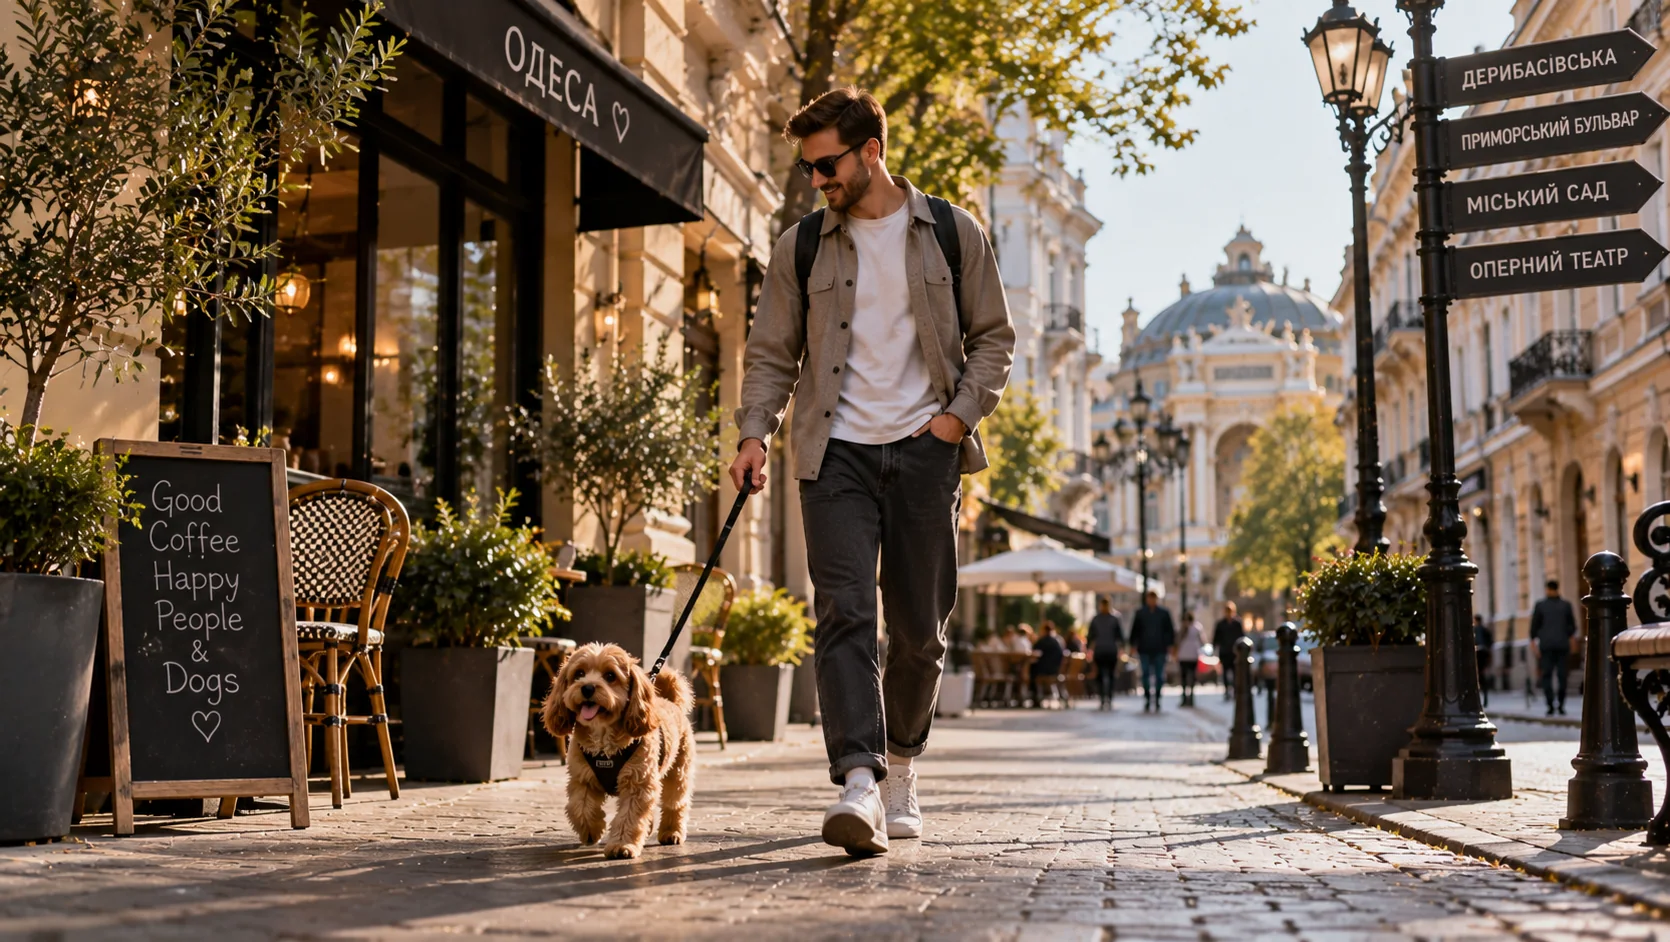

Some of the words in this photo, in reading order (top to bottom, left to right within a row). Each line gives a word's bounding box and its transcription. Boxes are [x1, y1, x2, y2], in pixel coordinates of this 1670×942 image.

[504, 25, 600, 127] ОДЕСА
[1461, 48, 1618, 91] ДЕРИБАСІВСЬКА
[1461, 116, 1570, 151] ПРИМОРСЬКИЙ
[1574, 109, 1640, 135] БУЛЬВАР
[1467, 183, 1559, 214] МІСЬКИЙ
[1566, 180, 1609, 203] САД
[1470, 251, 1563, 279] ОПЕРНИЙ
[1570, 247, 1629, 270] ТЕАТР
[151, 479, 223, 517] Good
[149, 520, 240, 554] Coffee
[153, 560, 239, 602] Happy
[154, 600, 244, 641] People
[191, 639, 209, 663] &
[163, 660, 240, 706] Dogs
